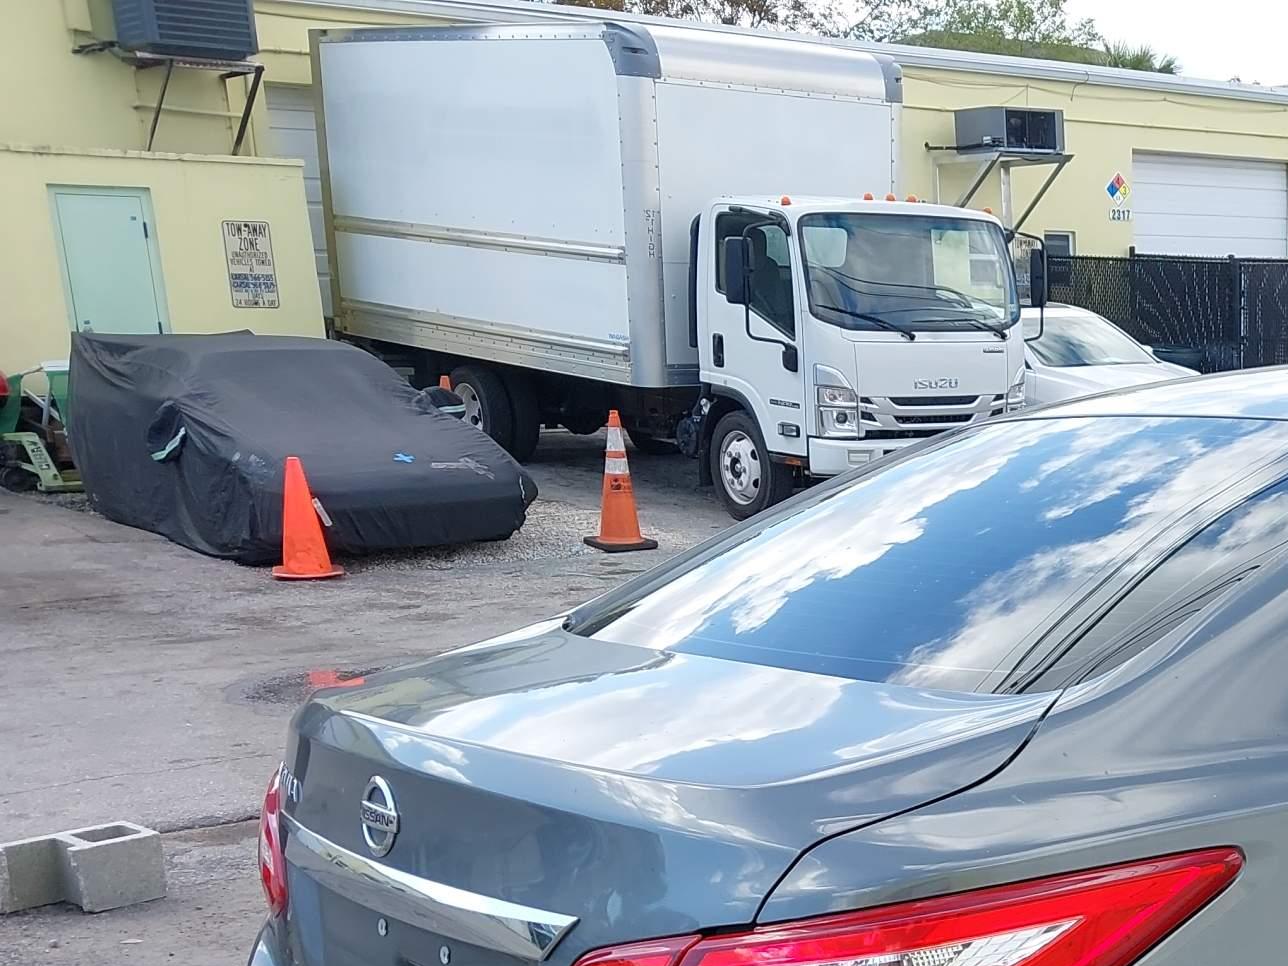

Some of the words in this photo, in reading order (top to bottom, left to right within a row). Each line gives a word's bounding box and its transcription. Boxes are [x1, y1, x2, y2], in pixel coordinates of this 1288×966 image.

[1111, 208, 1131, 221] 2317
[225, 222, 267, 238] TOW-AWAY
[238, 236, 260, 252] ZONE
[913, 377, 959, 390] ISUZU
